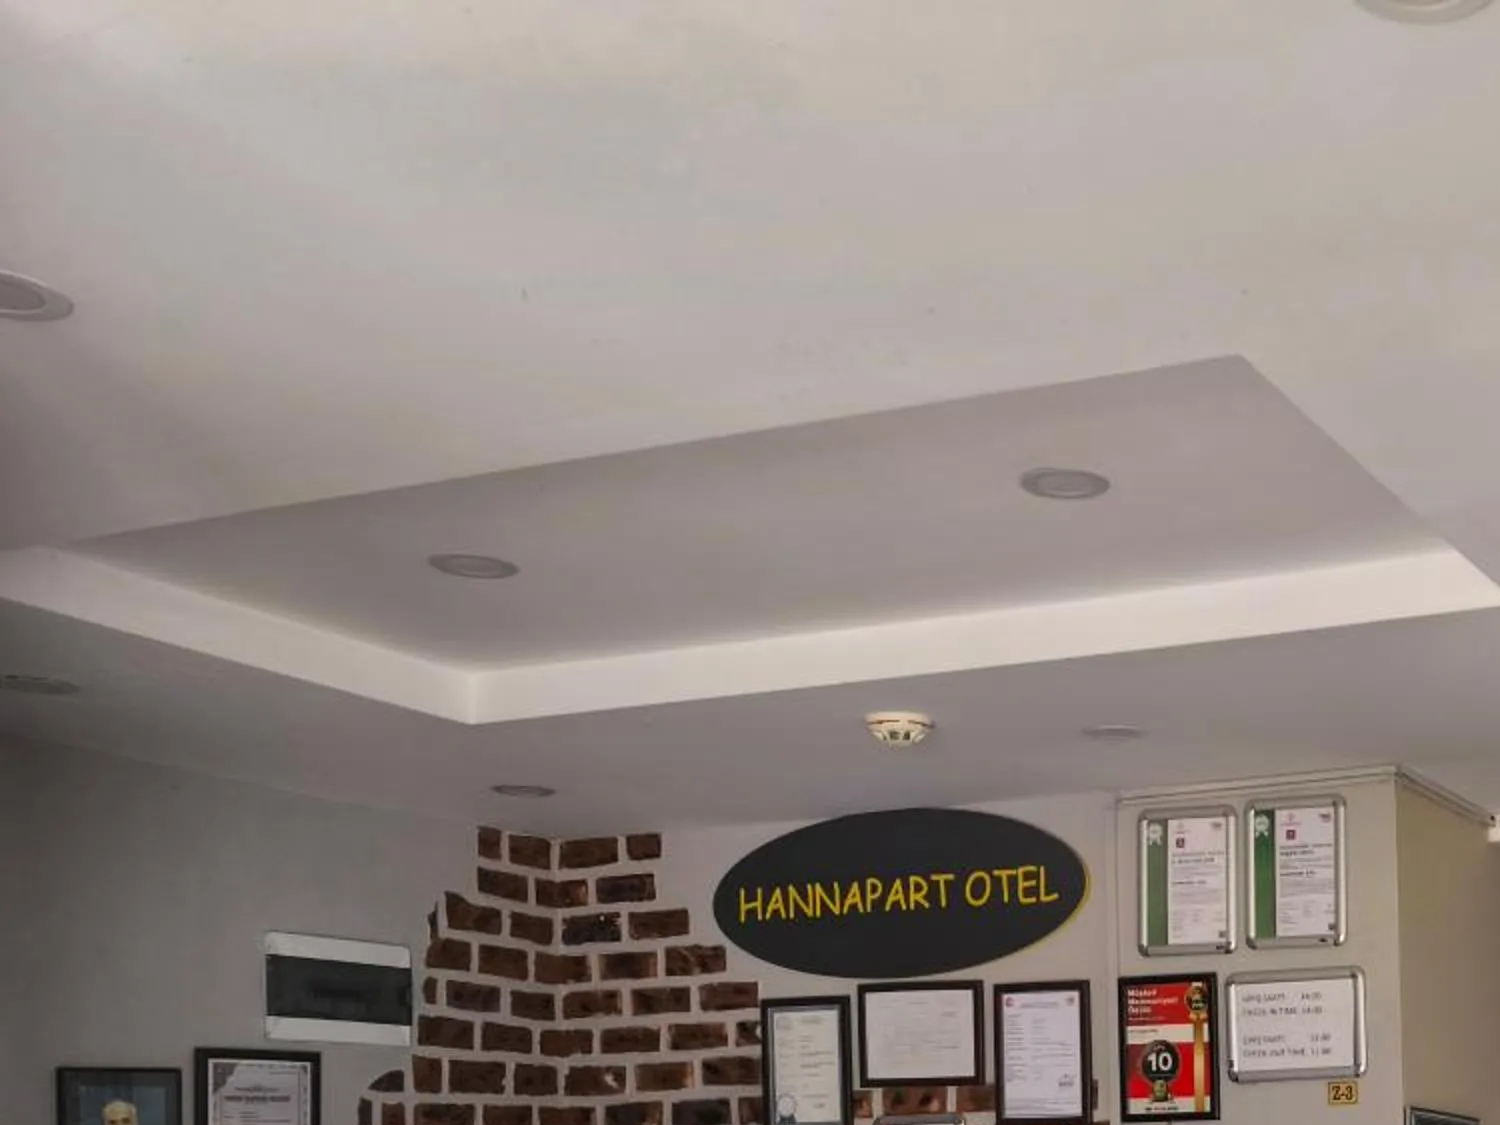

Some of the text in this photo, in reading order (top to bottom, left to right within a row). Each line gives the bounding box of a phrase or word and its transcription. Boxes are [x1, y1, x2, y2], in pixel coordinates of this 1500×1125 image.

[738, 865, 1060, 924] HANNAPART OTEL
[1147, 1051, 1173, 1071] 10
